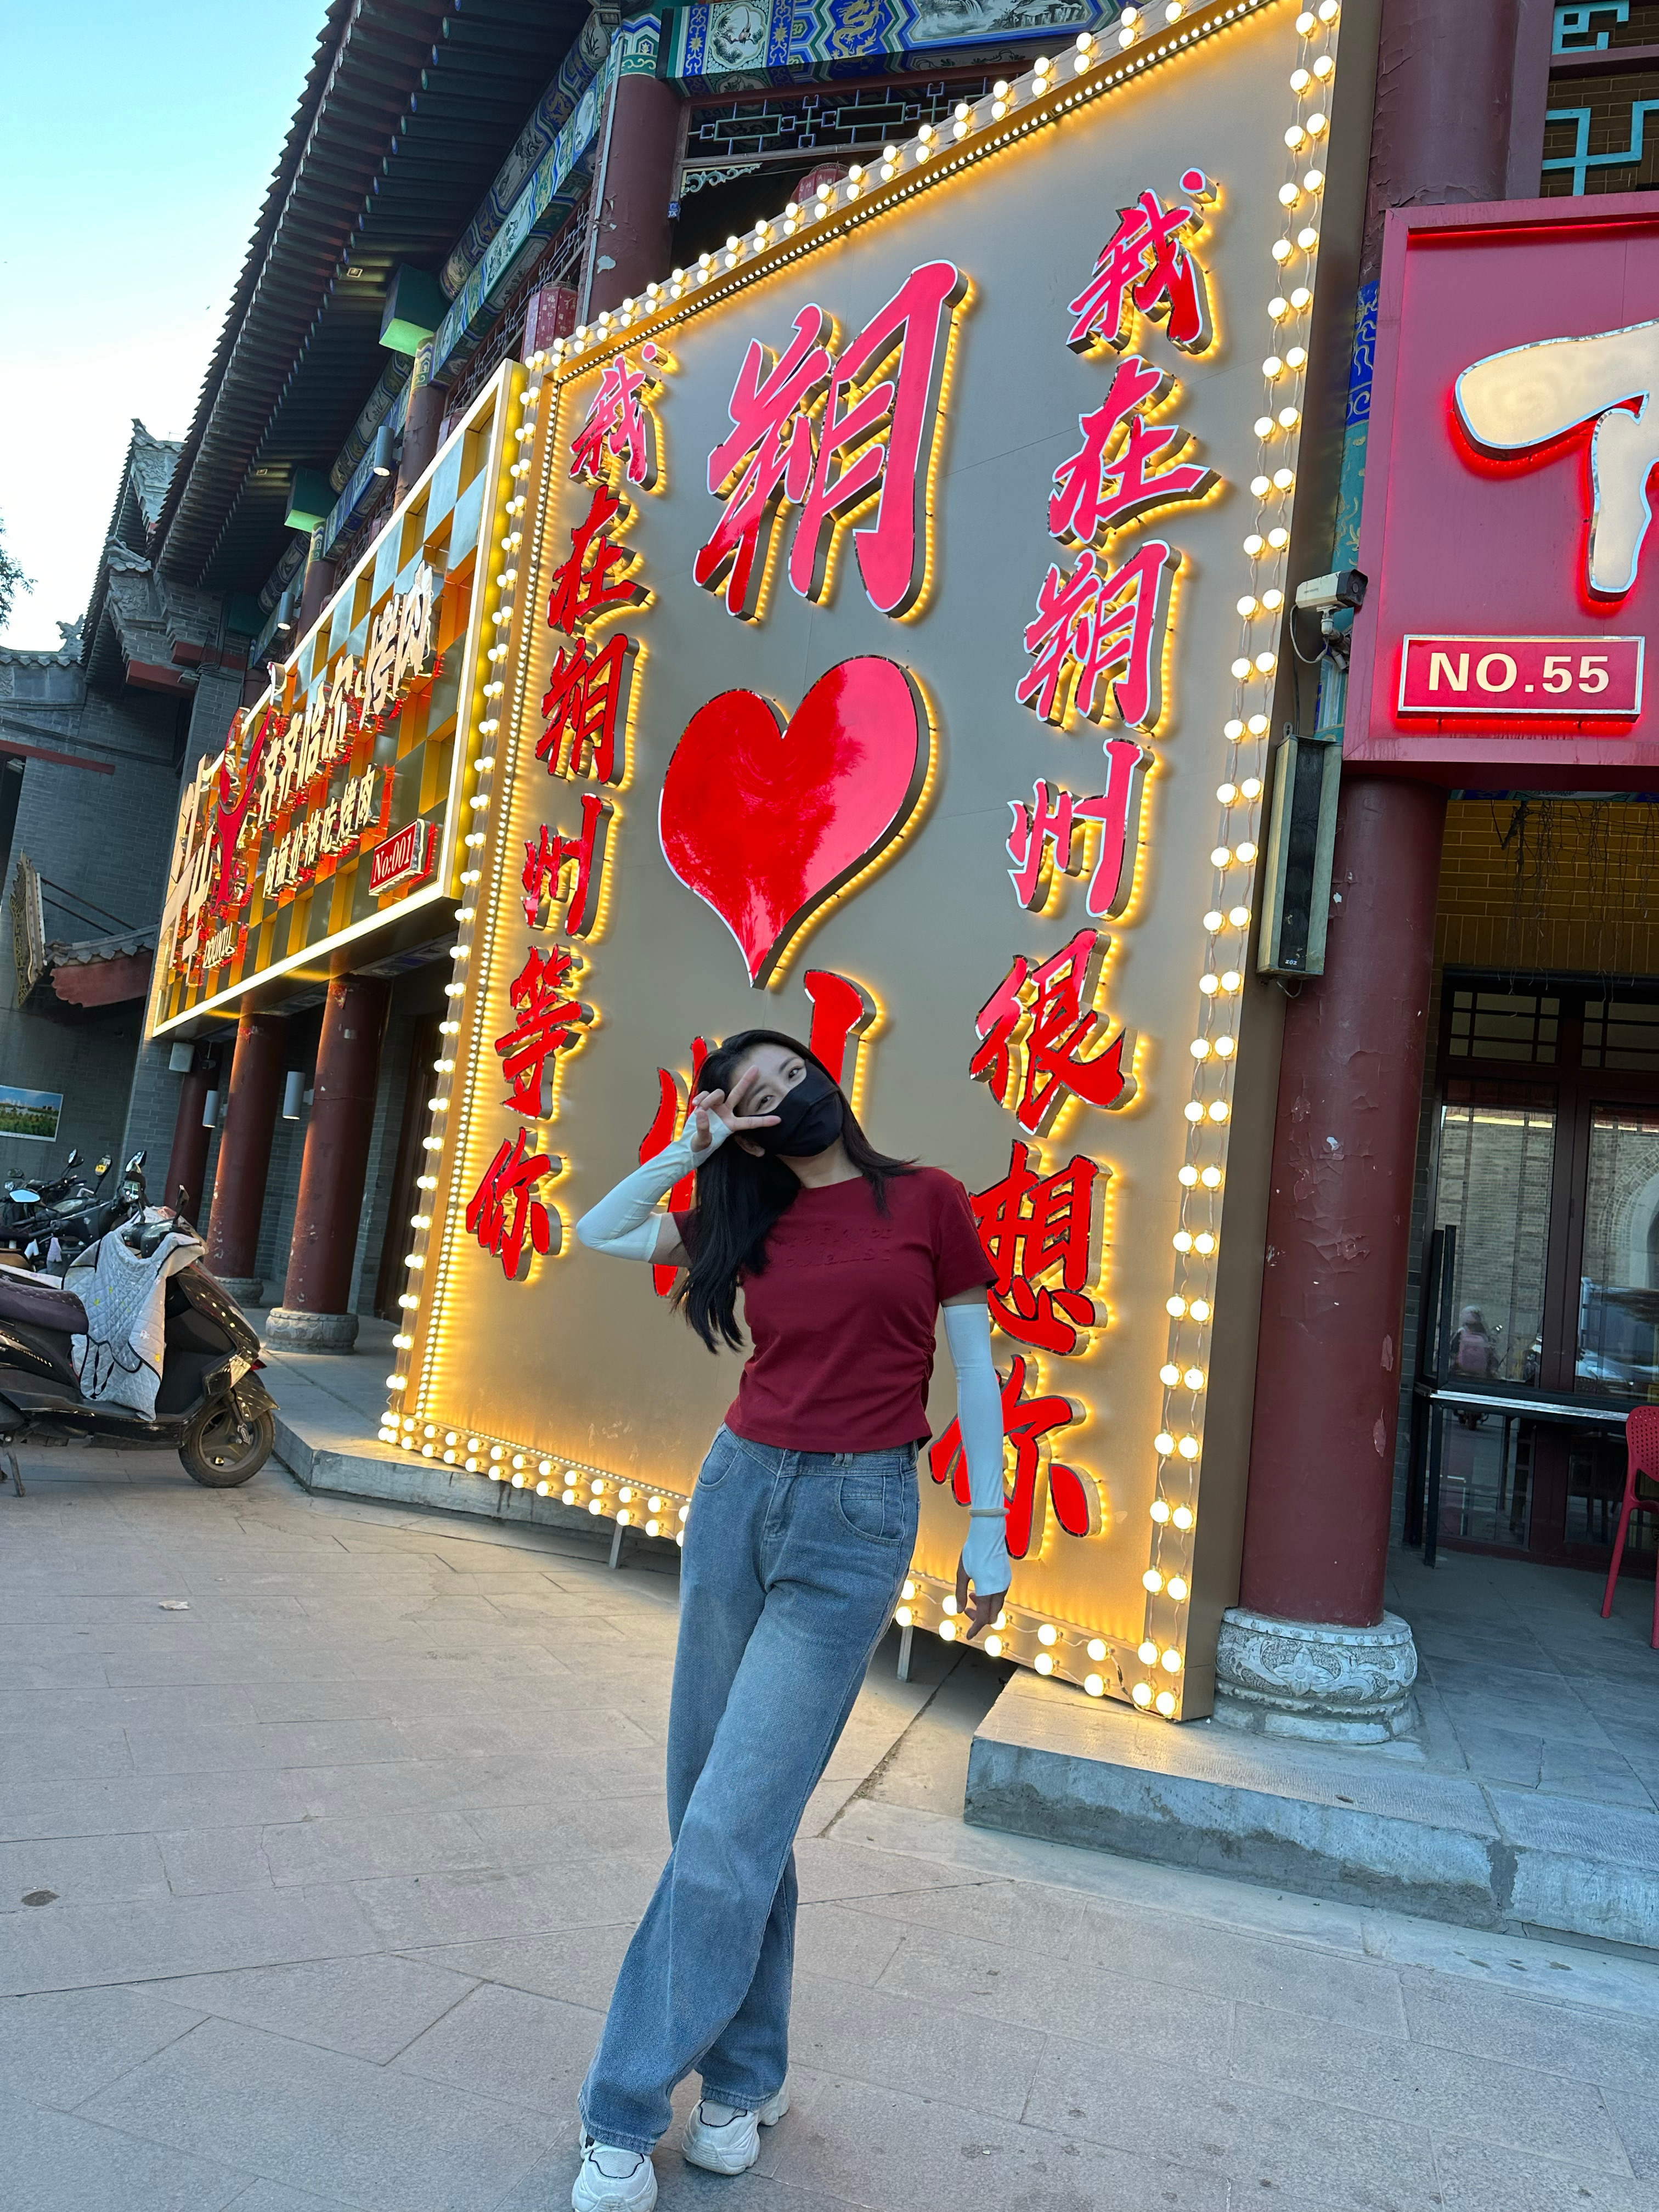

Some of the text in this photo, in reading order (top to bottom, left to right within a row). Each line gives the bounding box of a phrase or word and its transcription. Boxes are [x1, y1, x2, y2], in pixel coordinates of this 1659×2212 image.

[693, 259, 958, 617] 朔
[1428, 652, 1610, 693] NO.55
[263, 764, 375, 898] 肉铺价格吃烤肉
[373, 832, 411, 883] No:001
[466, 342, 657, 1280] 我在朔州等你
[929, 168, 1210, 1559] 我在朔州很想你
